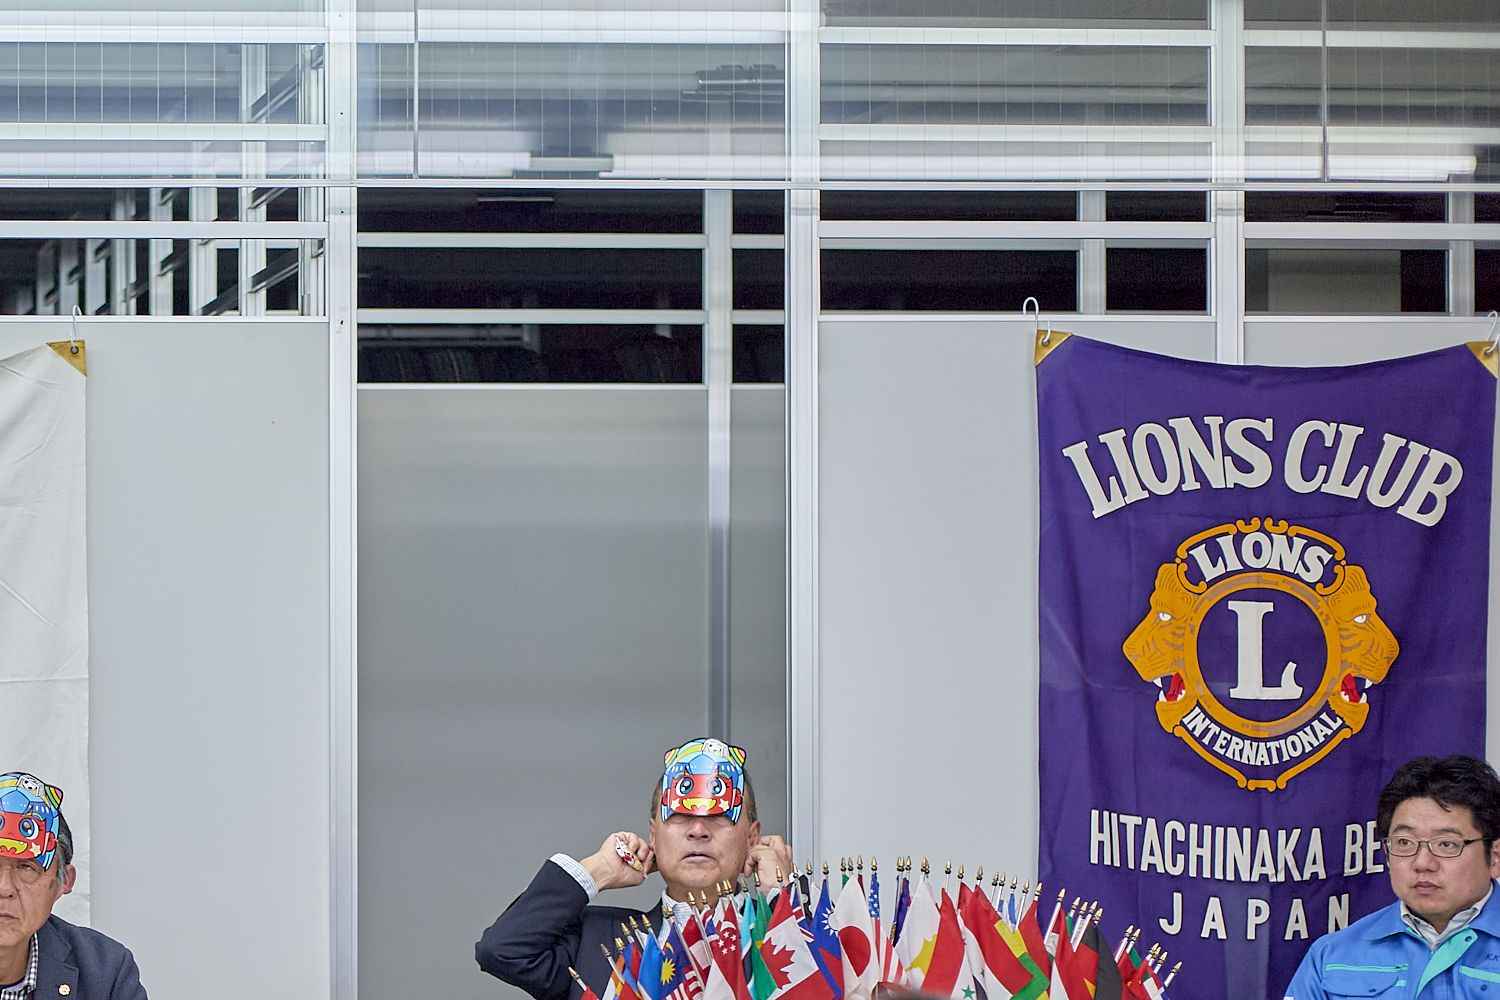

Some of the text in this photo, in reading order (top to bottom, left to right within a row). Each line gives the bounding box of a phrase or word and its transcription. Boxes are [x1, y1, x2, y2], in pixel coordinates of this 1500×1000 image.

[1062, 415, 1464, 527] LIONS CLUB
[1189, 531, 1333, 583] LIONS
[1228, 600, 1303, 700] L
[1182, 706, 1344, 766] INTERNATIONAL
[1090, 808, 1327, 883] HITACHINAKA
[1158, 892, 1350, 941] JAPAN
